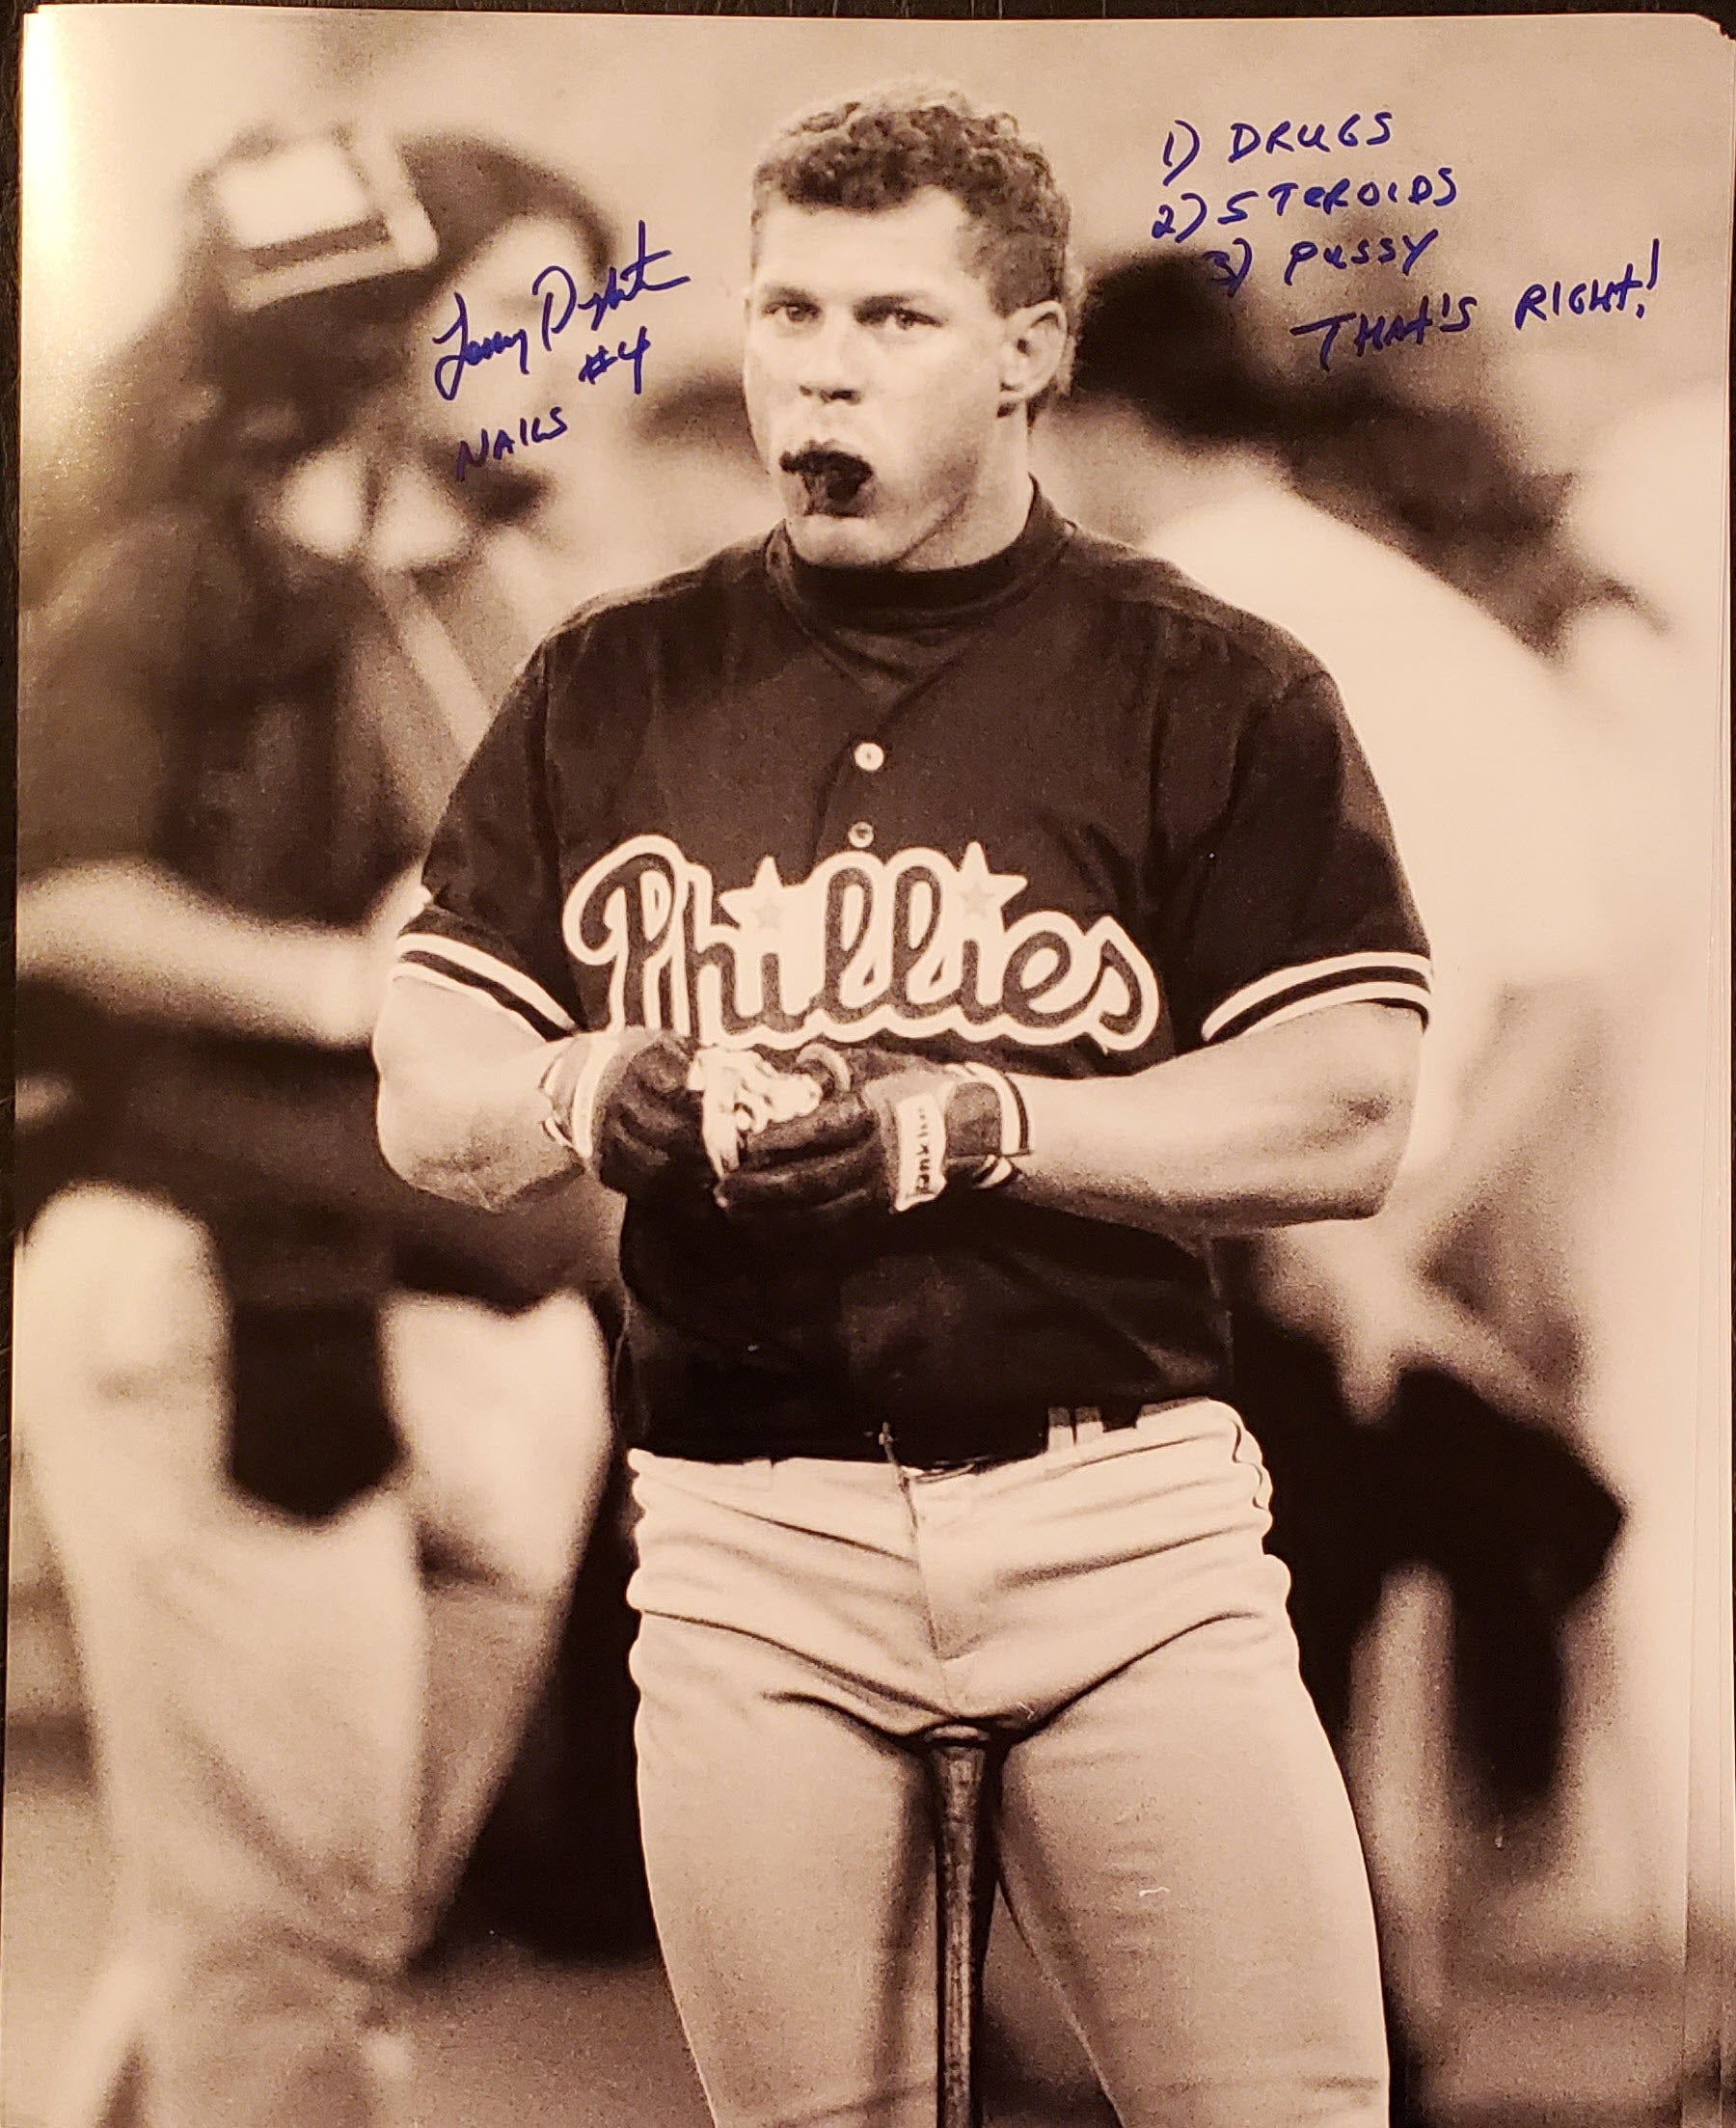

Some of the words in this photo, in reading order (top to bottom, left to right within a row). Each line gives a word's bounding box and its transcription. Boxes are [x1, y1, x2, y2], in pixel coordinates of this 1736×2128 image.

[1162, 120, 1200, 185] 1)
[1228, 112, 1392, 162] DRUGS
[1151, 193, 1207, 242] 2)
[1203, 238, 1252, 297] 3)
[1514, 237, 1659, 330] RIGHT!
[579, 325, 651, 396] #4
[456, 406, 568, 482] NAILS
[562, 833, 1160, 1051] Phillies
